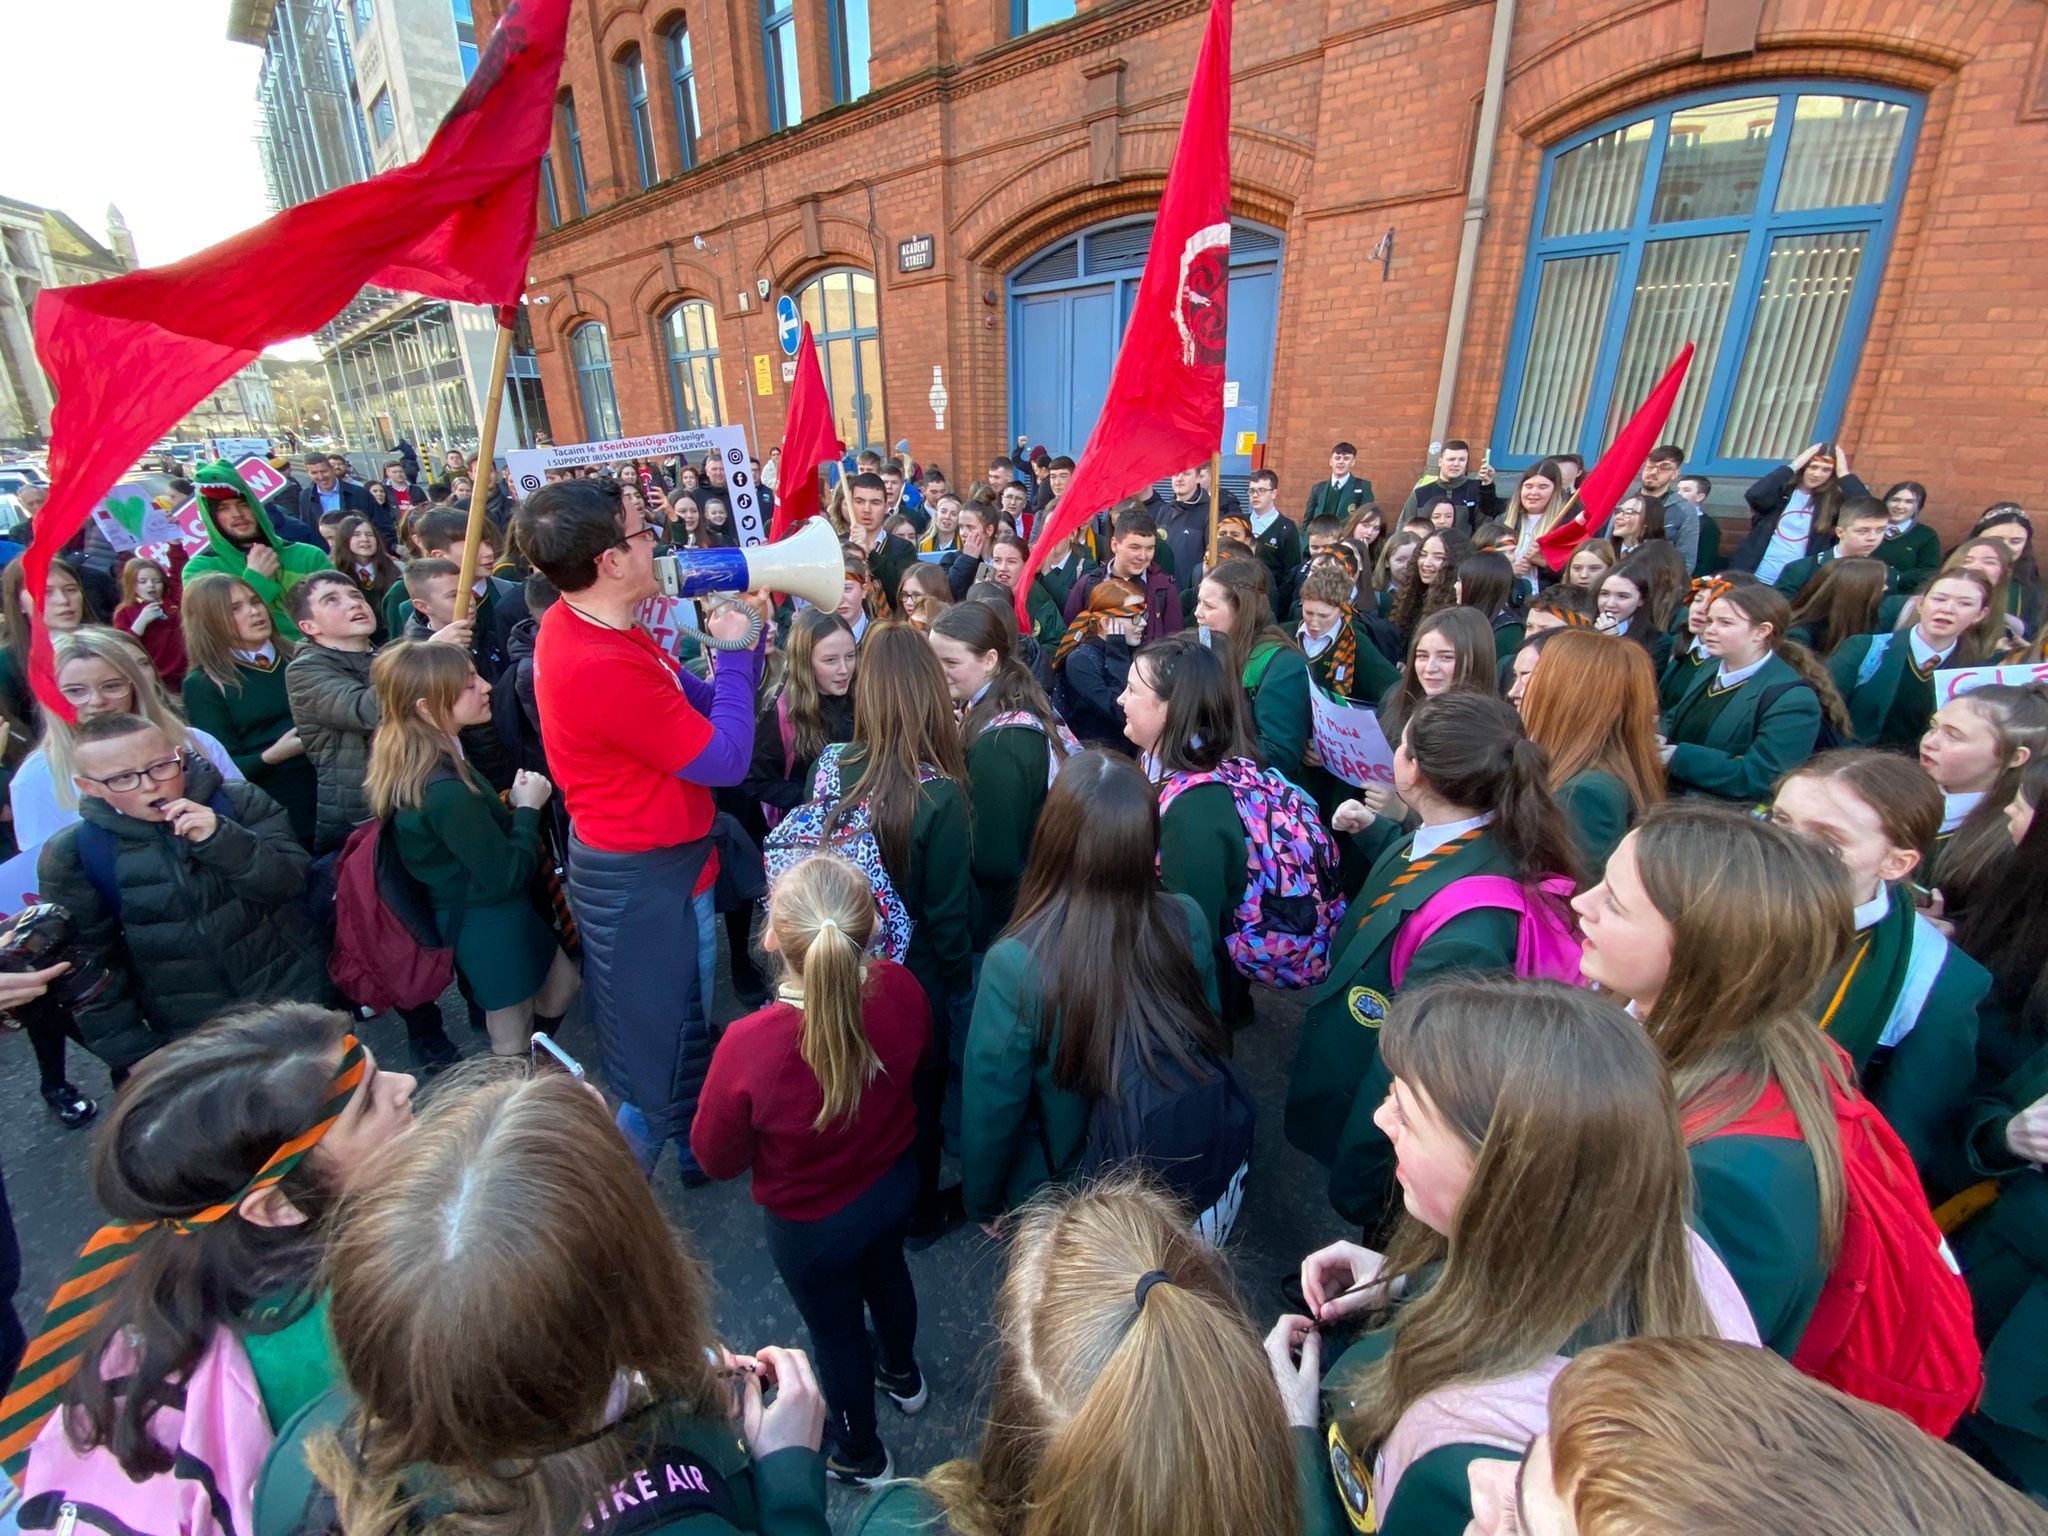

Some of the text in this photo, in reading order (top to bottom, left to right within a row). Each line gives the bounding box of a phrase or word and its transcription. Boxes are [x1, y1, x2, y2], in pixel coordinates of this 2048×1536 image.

[902, 240, 928, 255] ACADEMY
[905, 253, 926, 267] STREET
[553, 455, 590, 467] SUPPORT
[592, 453, 614, 462] IRISH
[615, 449, 650, 459] MEDIUM
[651, 446, 679, 455] YOUTH
[680, 440, 714, 451] SERVICES
[586, 445, 596, 453] le
[669, 432, 705, 444] Ghaeilge
[1317, 738, 1395, 785] FEARG
[665, 1463, 711, 1493] AIR
